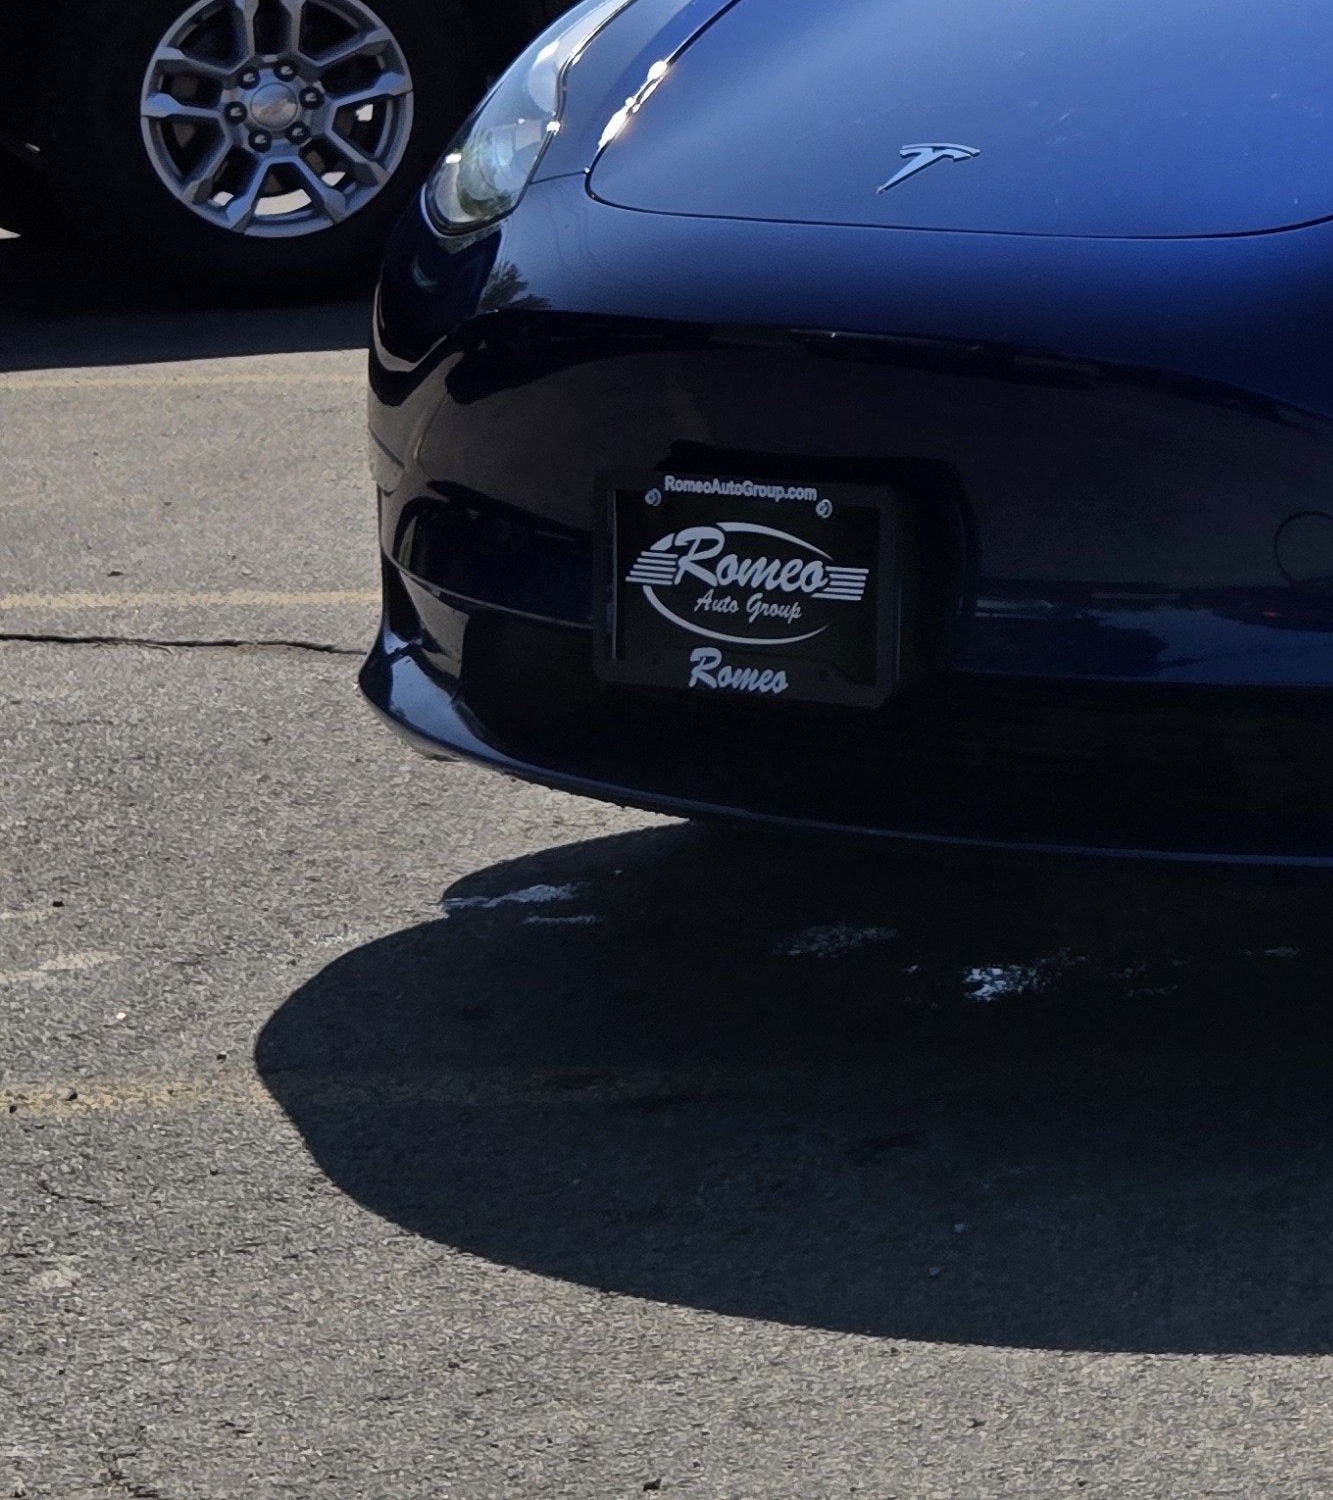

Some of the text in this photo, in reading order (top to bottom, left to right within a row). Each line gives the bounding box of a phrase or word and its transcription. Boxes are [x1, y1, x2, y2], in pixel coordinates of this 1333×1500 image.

[665, 475, 817, 502] RomeoAutoGroup.com
[675, 526, 828, 593] Romeo
[695, 589, 802, 623] Auto Group
[689, 647, 788, 694] Romeo
